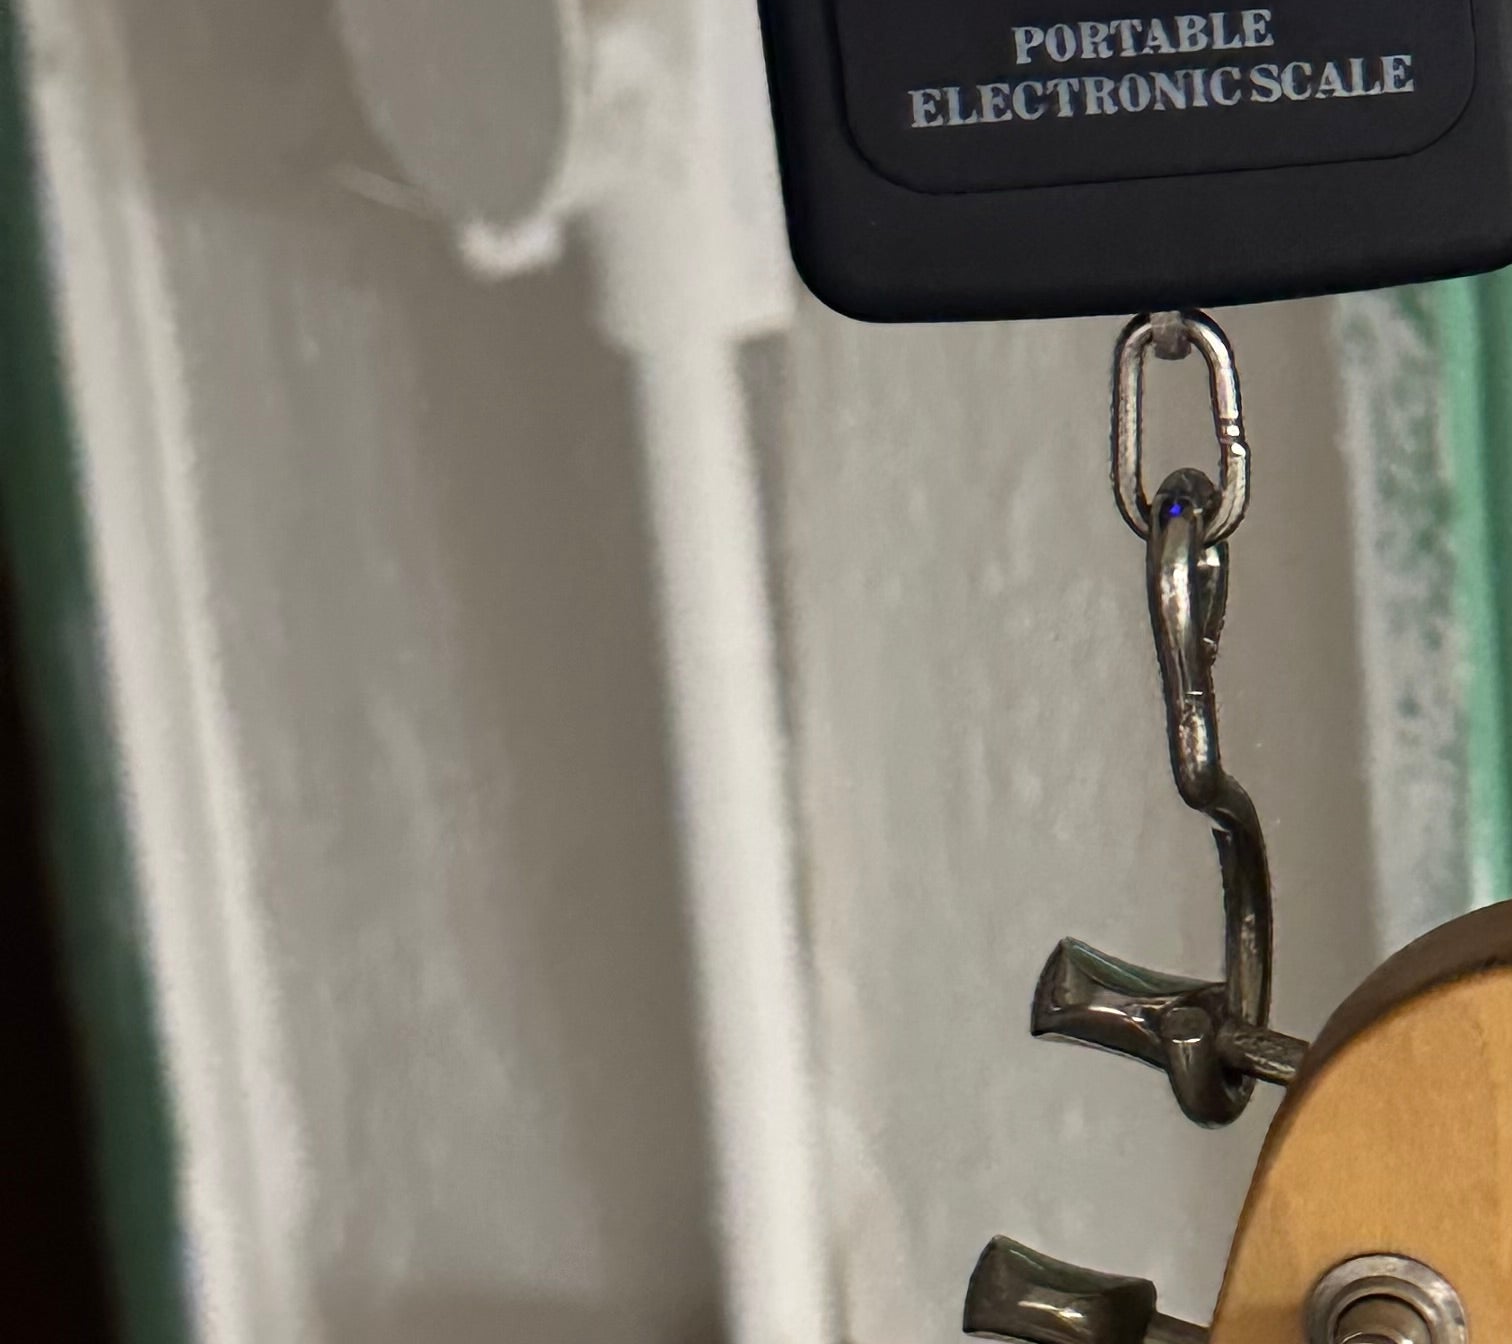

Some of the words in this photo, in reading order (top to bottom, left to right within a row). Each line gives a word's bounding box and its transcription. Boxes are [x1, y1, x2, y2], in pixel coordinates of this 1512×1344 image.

[1011, 8, 1275, 65] PORTABLE
[908, 64, 1246, 129] ELECTRONIC
[1250, 54, 1416, 104] SCALE
